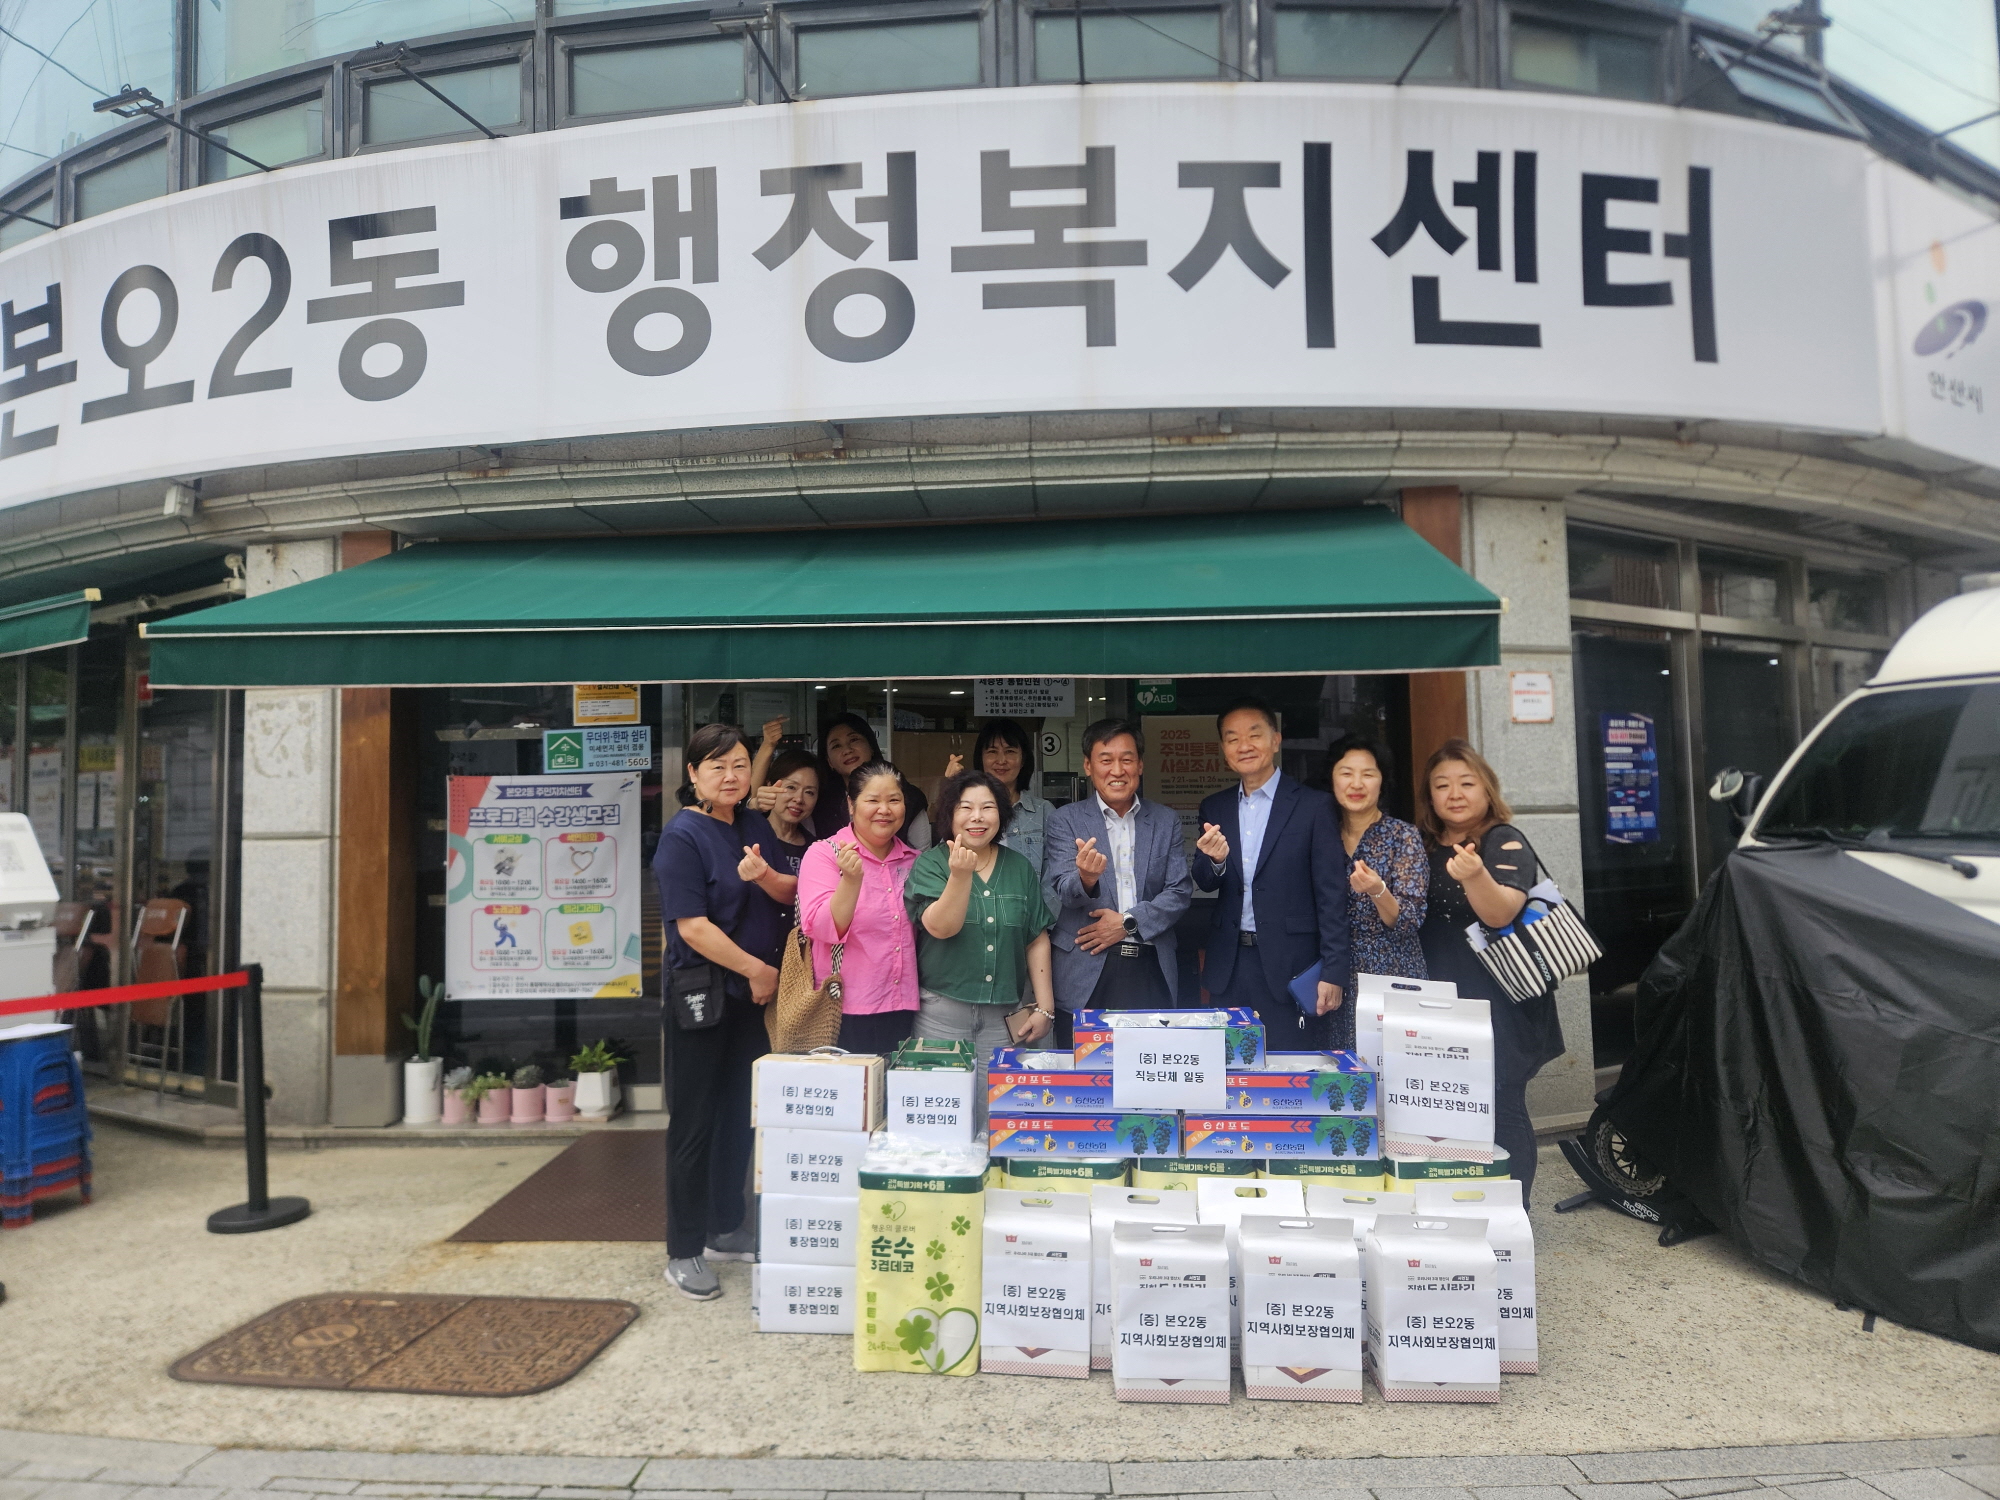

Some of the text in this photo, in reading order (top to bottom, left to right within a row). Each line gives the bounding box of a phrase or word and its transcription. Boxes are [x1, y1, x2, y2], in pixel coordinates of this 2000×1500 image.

[0, 141, 1719, 460] 본오2동 행정복지센터
[1007, 678, 1040, 686] 통합민원
[1153, 694, 1175, 704] AED
[586, 729, 648, 744] 무더위·한파 쉼터
[1161, 730, 1191, 740] 2025
[1160, 742, 1219, 757] 주민등록
[595, 758, 649, 767] 031-481-5605
[1161, 758, 1221, 773] 사실조사
[506, 786, 583, 797] 본오2동 주민자치센터
[469, 804, 620, 828] 프로그램 수강생모집
[1162, 1053, 1200, 1066] 본오2동
[1005, 1075, 1051, 1084] 송산포도
[1135, 1070, 1205, 1083] 직능단체 일동
[1227, 1077, 1248, 1086] 포도
[803, 1087, 839, 1100] 본오2동
[1430, 1080, 1470, 1095] 본오2동
[924, 1096, 961, 1109] 본오2동
[1075, 1097, 1105, 1105] 송산농협
[1273, 1098, 1302, 1106] 송산농협
[1388, 1093, 1490, 1115] 지역사회보장협의체
[785, 1103, 835, 1117] 통장협의회
[906, 1113, 958, 1126] 통장협의회
[1006, 1120, 1053, 1129] 송산포도
[1203, 1121, 1250, 1130] 송산포도
[1077, 1142, 1107, 1150] 송산농협
[1275, 1143, 1305, 1151] 송산농협
[808, 1153, 844, 1167] 본오2동
[790, 1170, 840, 1183] 통장협의회
[807, 1219, 843, 1232] 본오2동
[871, 1223, 916, 1233] 행운의 클로버
[789, 1236, 840, 1249] 통장협의회
[871, 1235, 915, 1259] 순수
[870, 1259, 915, 1273] 3겹데코
[806, 1286, 843, 1298] 본오2동
[1027, 1286, 1067, 1301] 본오2동
[1498, 1288, 1513, 1300] 2동
[788, 1303, 840, 1315] 통장협의회
[984, 1302, 1085, 1321] 지역사회보장협의체
[1292, 1304, 1335, 1319] 본오2동
[1165, 1314, 1207, 1329] 본오2동
[1433, 1317, 1475, 1330] 본오2동
[1247, 1321, 1355, 1340] 지역사회보장협의체
[1120, 1332, 1227, 1349] 지역사회보장협의체
[1388, 1335, 1496, 1350] 지역사회보장협의체
